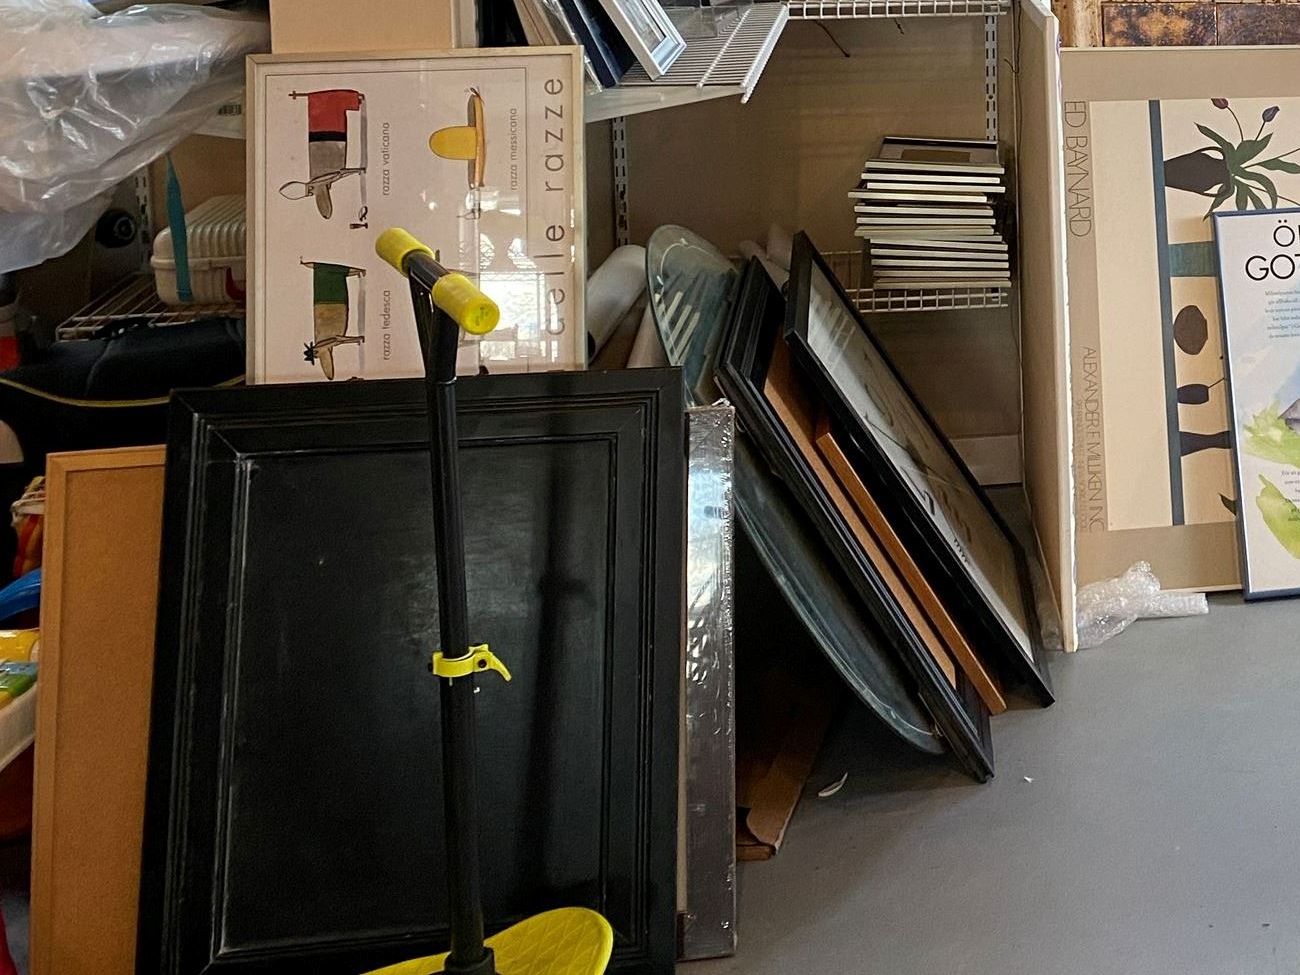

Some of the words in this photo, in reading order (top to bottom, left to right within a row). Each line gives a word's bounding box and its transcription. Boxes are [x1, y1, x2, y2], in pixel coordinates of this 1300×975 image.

[510, 107, 518, 163] messicana
[544, 78, 565, 193] razze
[1064, 101, 1087, 128] ED
[380, 121, 390, 167] vaticano
[382, 168, 391, 196] razza
[1065, 135, 1093, 238] BAYNARD
[380, 289, 392, 330] tedesca
[383, 331, 392, 361] razza
[1082, 346, 1101, 427] ALEXANDER
